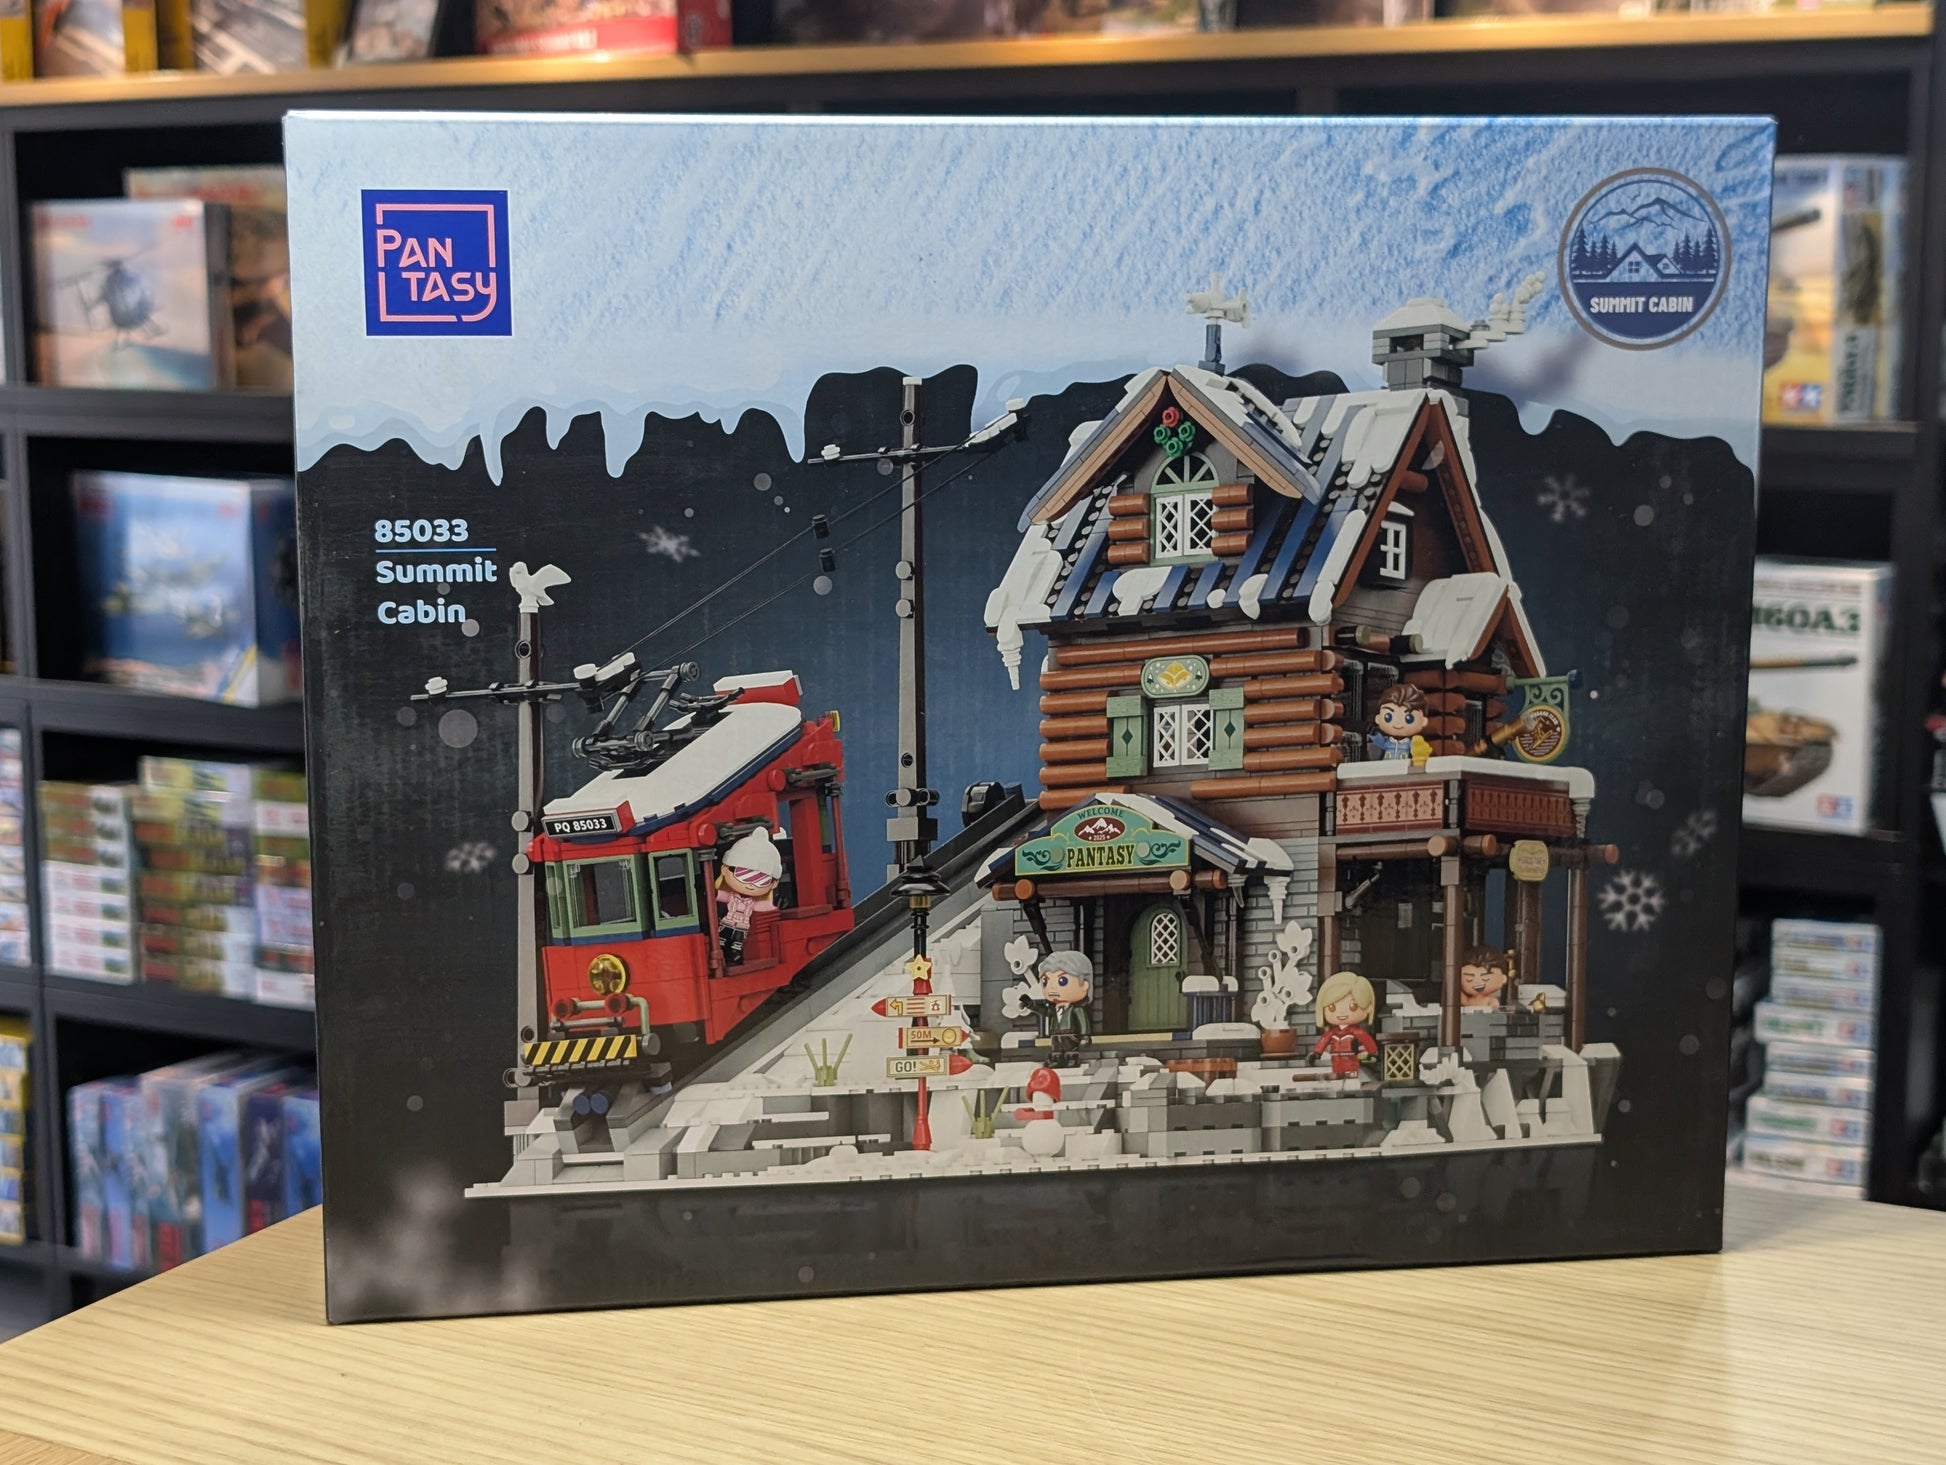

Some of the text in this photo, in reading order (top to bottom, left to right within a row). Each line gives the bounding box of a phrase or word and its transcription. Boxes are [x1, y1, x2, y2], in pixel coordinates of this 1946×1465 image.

[376, 228, 453, 268] PAN
[401, 271, 497, 322] TASY
[1590, 296, 1693, 313] SUMMIT CABIN
[374, 518, 469, 543] 85033
[376, 556, 498, 584] Summit
[377, 597, 466, 625] Cabin
[1077, 806, 1124, 820] WELCOME
[554, 818, 608, 833] PQ 85033
[1066, 844, 1135, 868] PANTASY
[895, 1060, 917, 1073] GO!
